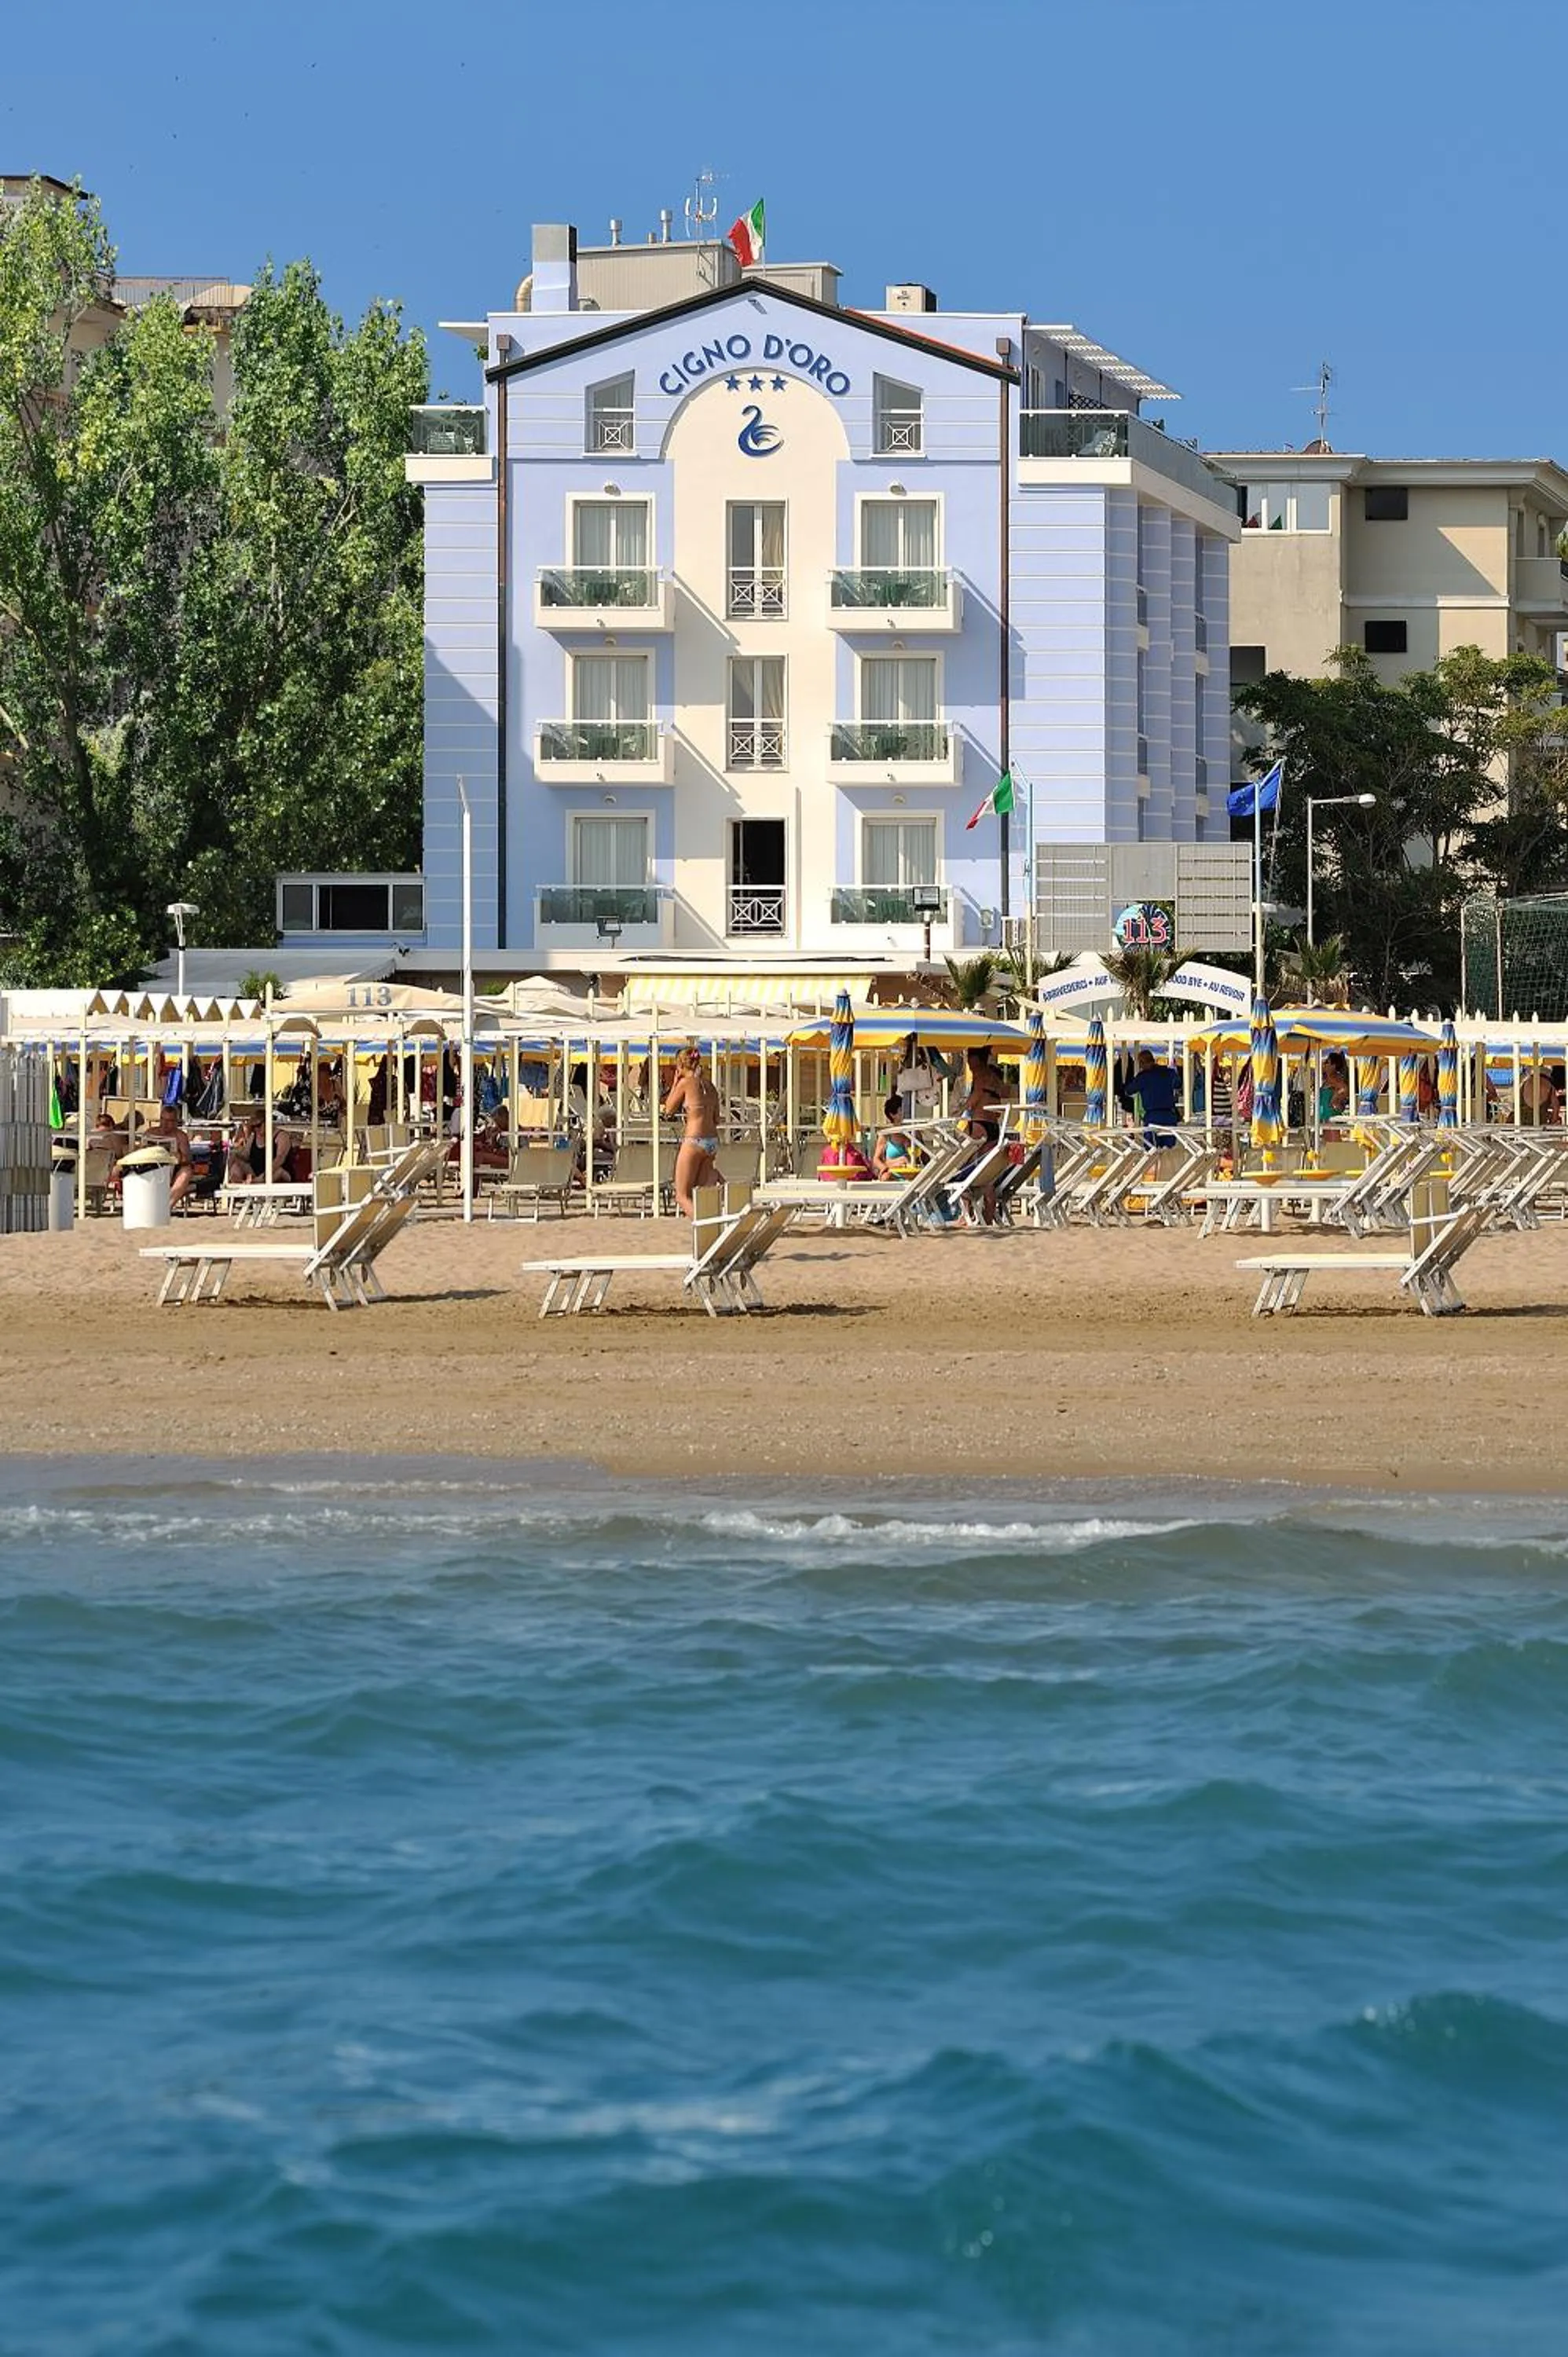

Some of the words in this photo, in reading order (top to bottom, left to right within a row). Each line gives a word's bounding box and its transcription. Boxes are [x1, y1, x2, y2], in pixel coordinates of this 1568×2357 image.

[659, 334, 752, 394] CIGNO
[763, 334, 851, 395] D'ORO
[1123, 917, 1167, 944] 113
[346, 986, 392, 1006] 113
